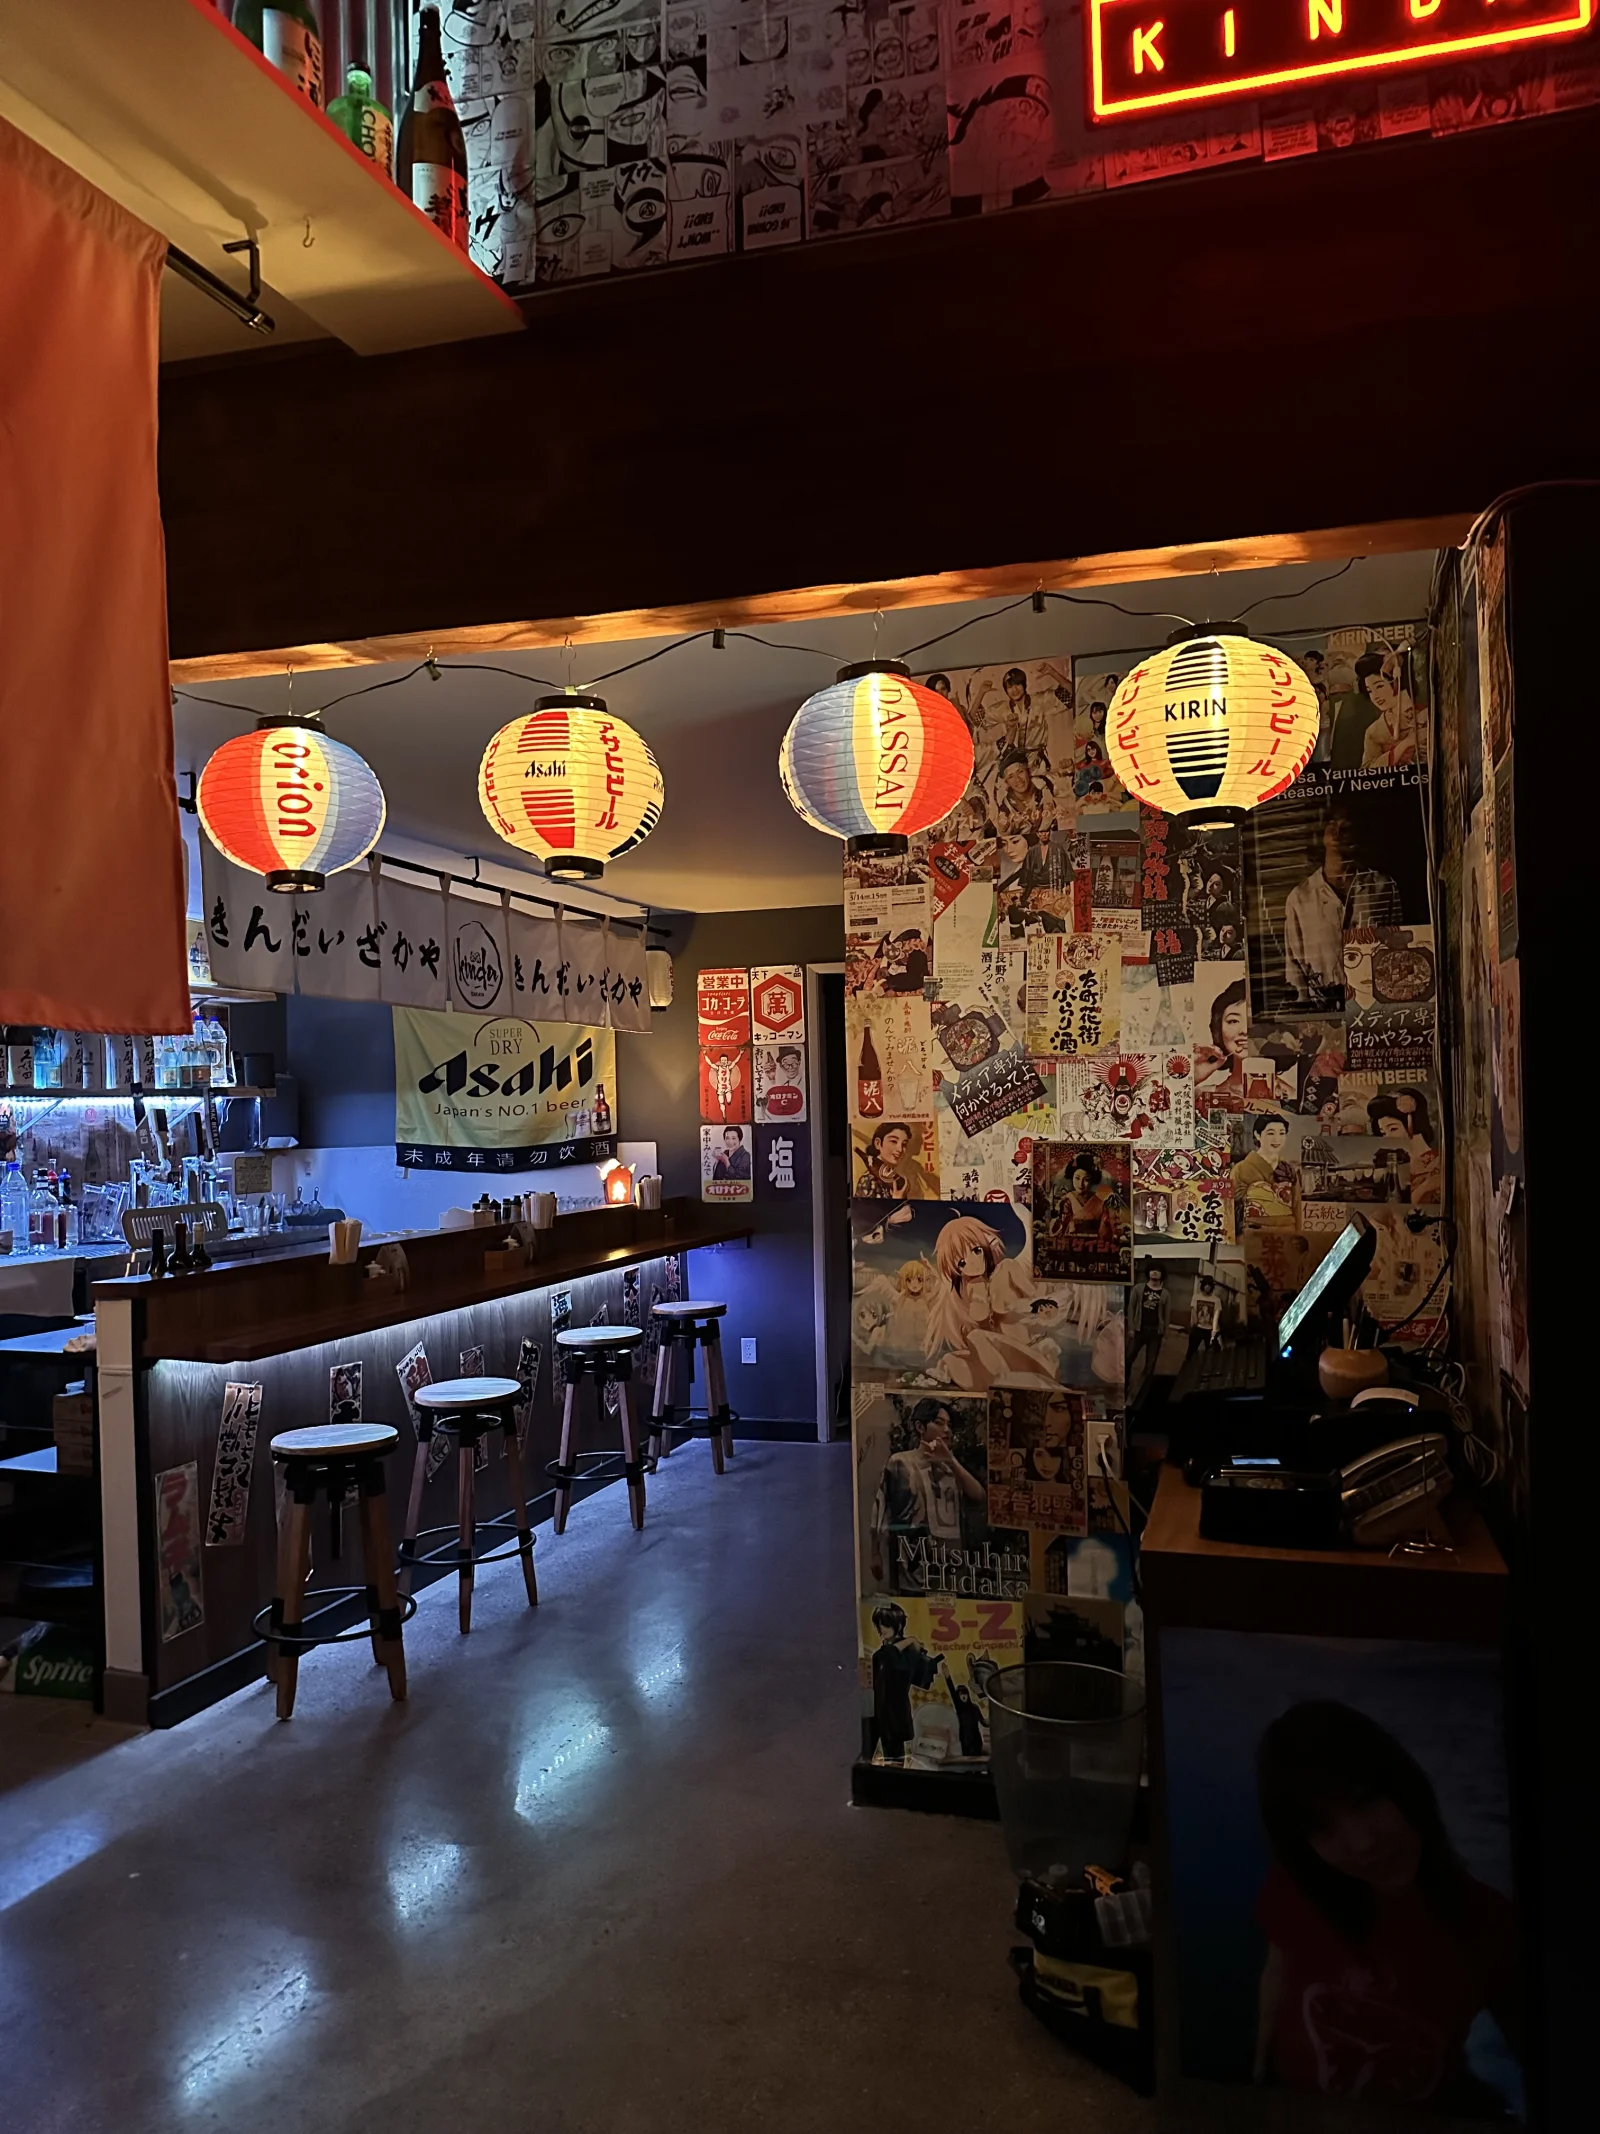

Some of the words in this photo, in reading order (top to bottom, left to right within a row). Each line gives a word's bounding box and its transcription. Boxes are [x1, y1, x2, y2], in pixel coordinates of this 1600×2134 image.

[1132, 0, 1497, 74] KIN
[362, 108, 377, 163] CHO
[1329, 632, 1371, 647] KIRIN
[1373, 624, 1415, 644] BEER
[1164, 697, 1227, 723] KIRIN
[1247, 653, 1299, 777] キリンビール
[1116, 668, 1162, 789] キリンビール
[875, 687, 910, 811] DASSAI
[524, 760, 567, 779] Asahi
[594, 720, 625, 831] アサヒビール
[1350, 775, 1395, 792] Never
[455, 936, 500, 991] kinda
[751, 970, 768, 981] 天下
[702, 975, 744, 989] 営業中
[701, 997, 745, 1011] コカ・コーラ
[1050, 982, 1078, 1054] ぶらり酒
[1078, 970, 1102, 1047] 古町花街
[489, 1027, 523, 1039] SUPER
[490, 1038, 523, 1056] DRY
[754, 1031, 803, 1042] キッコーマン
[418, 1037, 593, 1098] Asahi
[720, 1069, 728, 1091] グリコ
[1339, 1071, 1383, 1086] KIRIN
[1384, 1068, 1429, 1084] BEER
[434, 1103, 493, 1119] Japan's
[499, 1102, 538, 1117] NO.1
[546, 1098, 587, 1113] beer
[955, 1064, 1036, 1121] 何かやるってよ
[404, 1140, 611, 1168] 未成年请勿饮酒
[702, 1127, 712, 1176] 家中みんなで
[768, 1136, 796, 1189] 塩
[1303, 1202, 1346, 1220] 伝統と
[919, 1563, 1030, 1599] Hidaka
[928, 1603, 1018, 1643] 3-Z
[22, 1652, 95, 1686] Sprite
